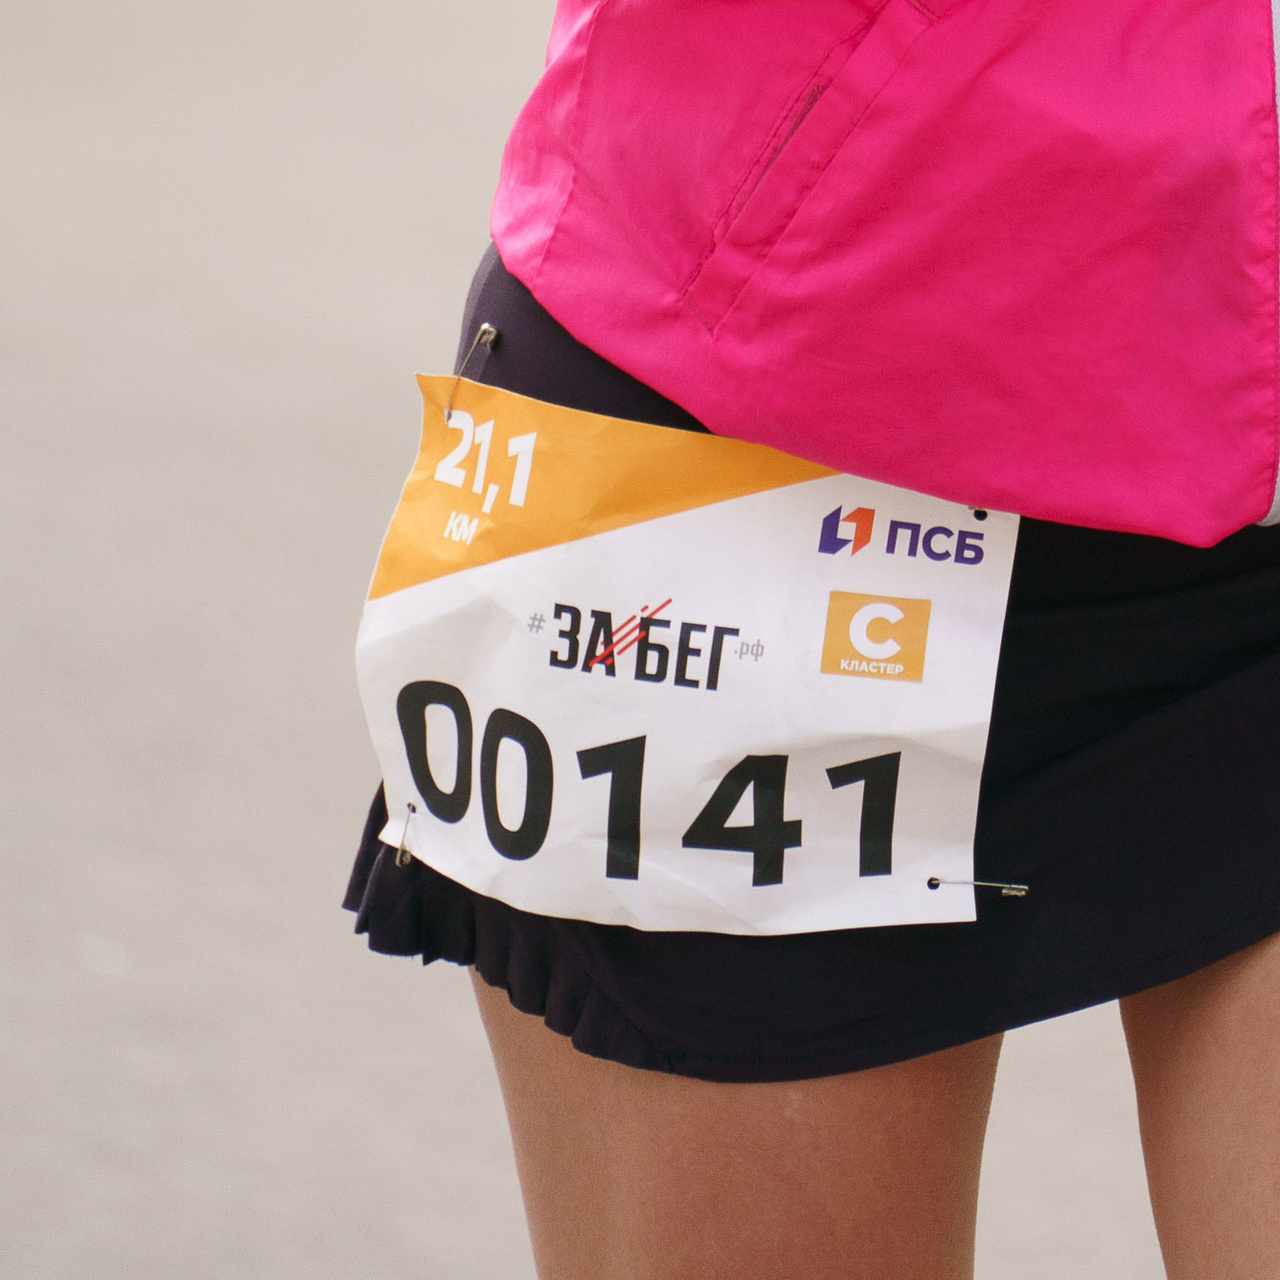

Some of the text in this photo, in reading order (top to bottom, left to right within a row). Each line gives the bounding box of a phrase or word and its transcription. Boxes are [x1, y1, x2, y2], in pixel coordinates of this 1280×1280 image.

[434, 408, 538, 515] 21,1
[885, 519, 985, 565] ПСБ
[839, 657, 905, 675] КЛАСТЕР
[396, 679, 903, 887] 00141
